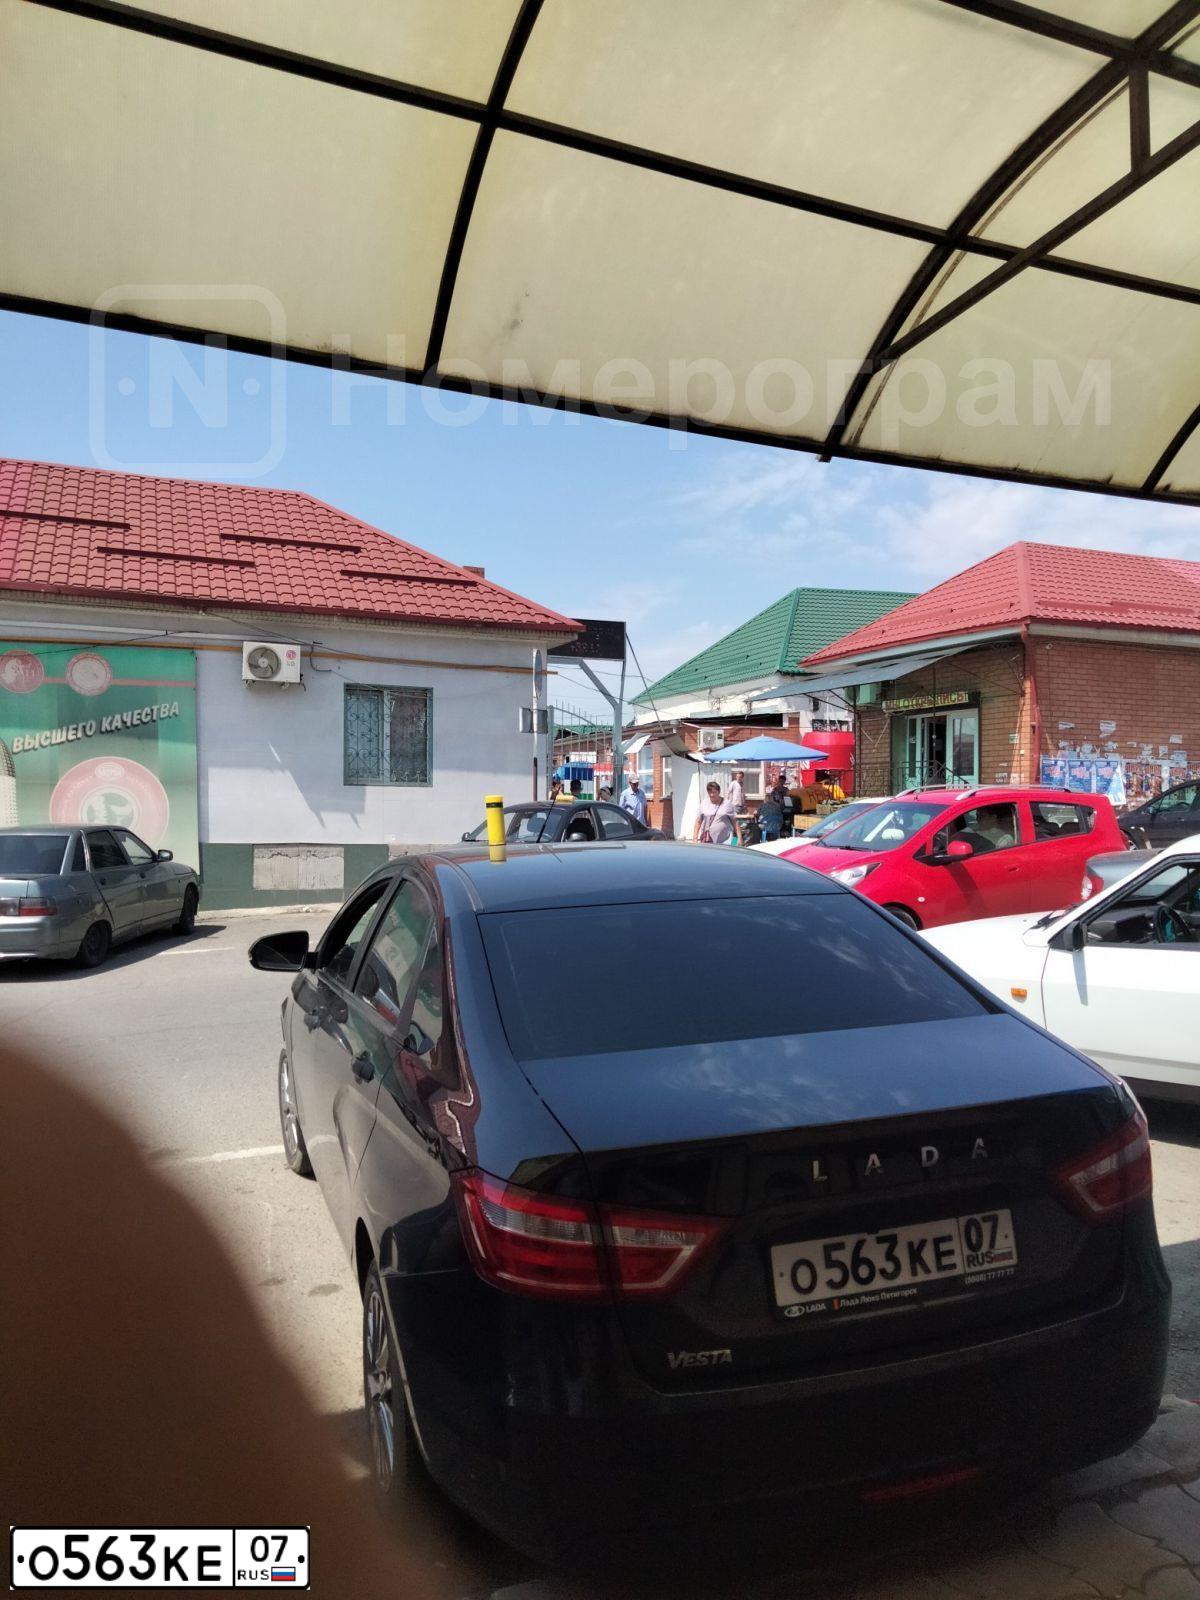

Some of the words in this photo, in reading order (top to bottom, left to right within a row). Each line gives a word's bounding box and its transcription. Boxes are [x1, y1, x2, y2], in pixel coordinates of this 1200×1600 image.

[12, 719, 97, 754] ВЫСШЕГО
[100, 702, 180, 734] КАЧЕСТВА
[812, 1137, 988, 1182] LADA
[964, 1214, 999, 1251] 07
[966, 1251, 994, 1268] RUS
[806, 1303, 826, 1313] LADA
[667, 1349, 733, 1369] VESTA
